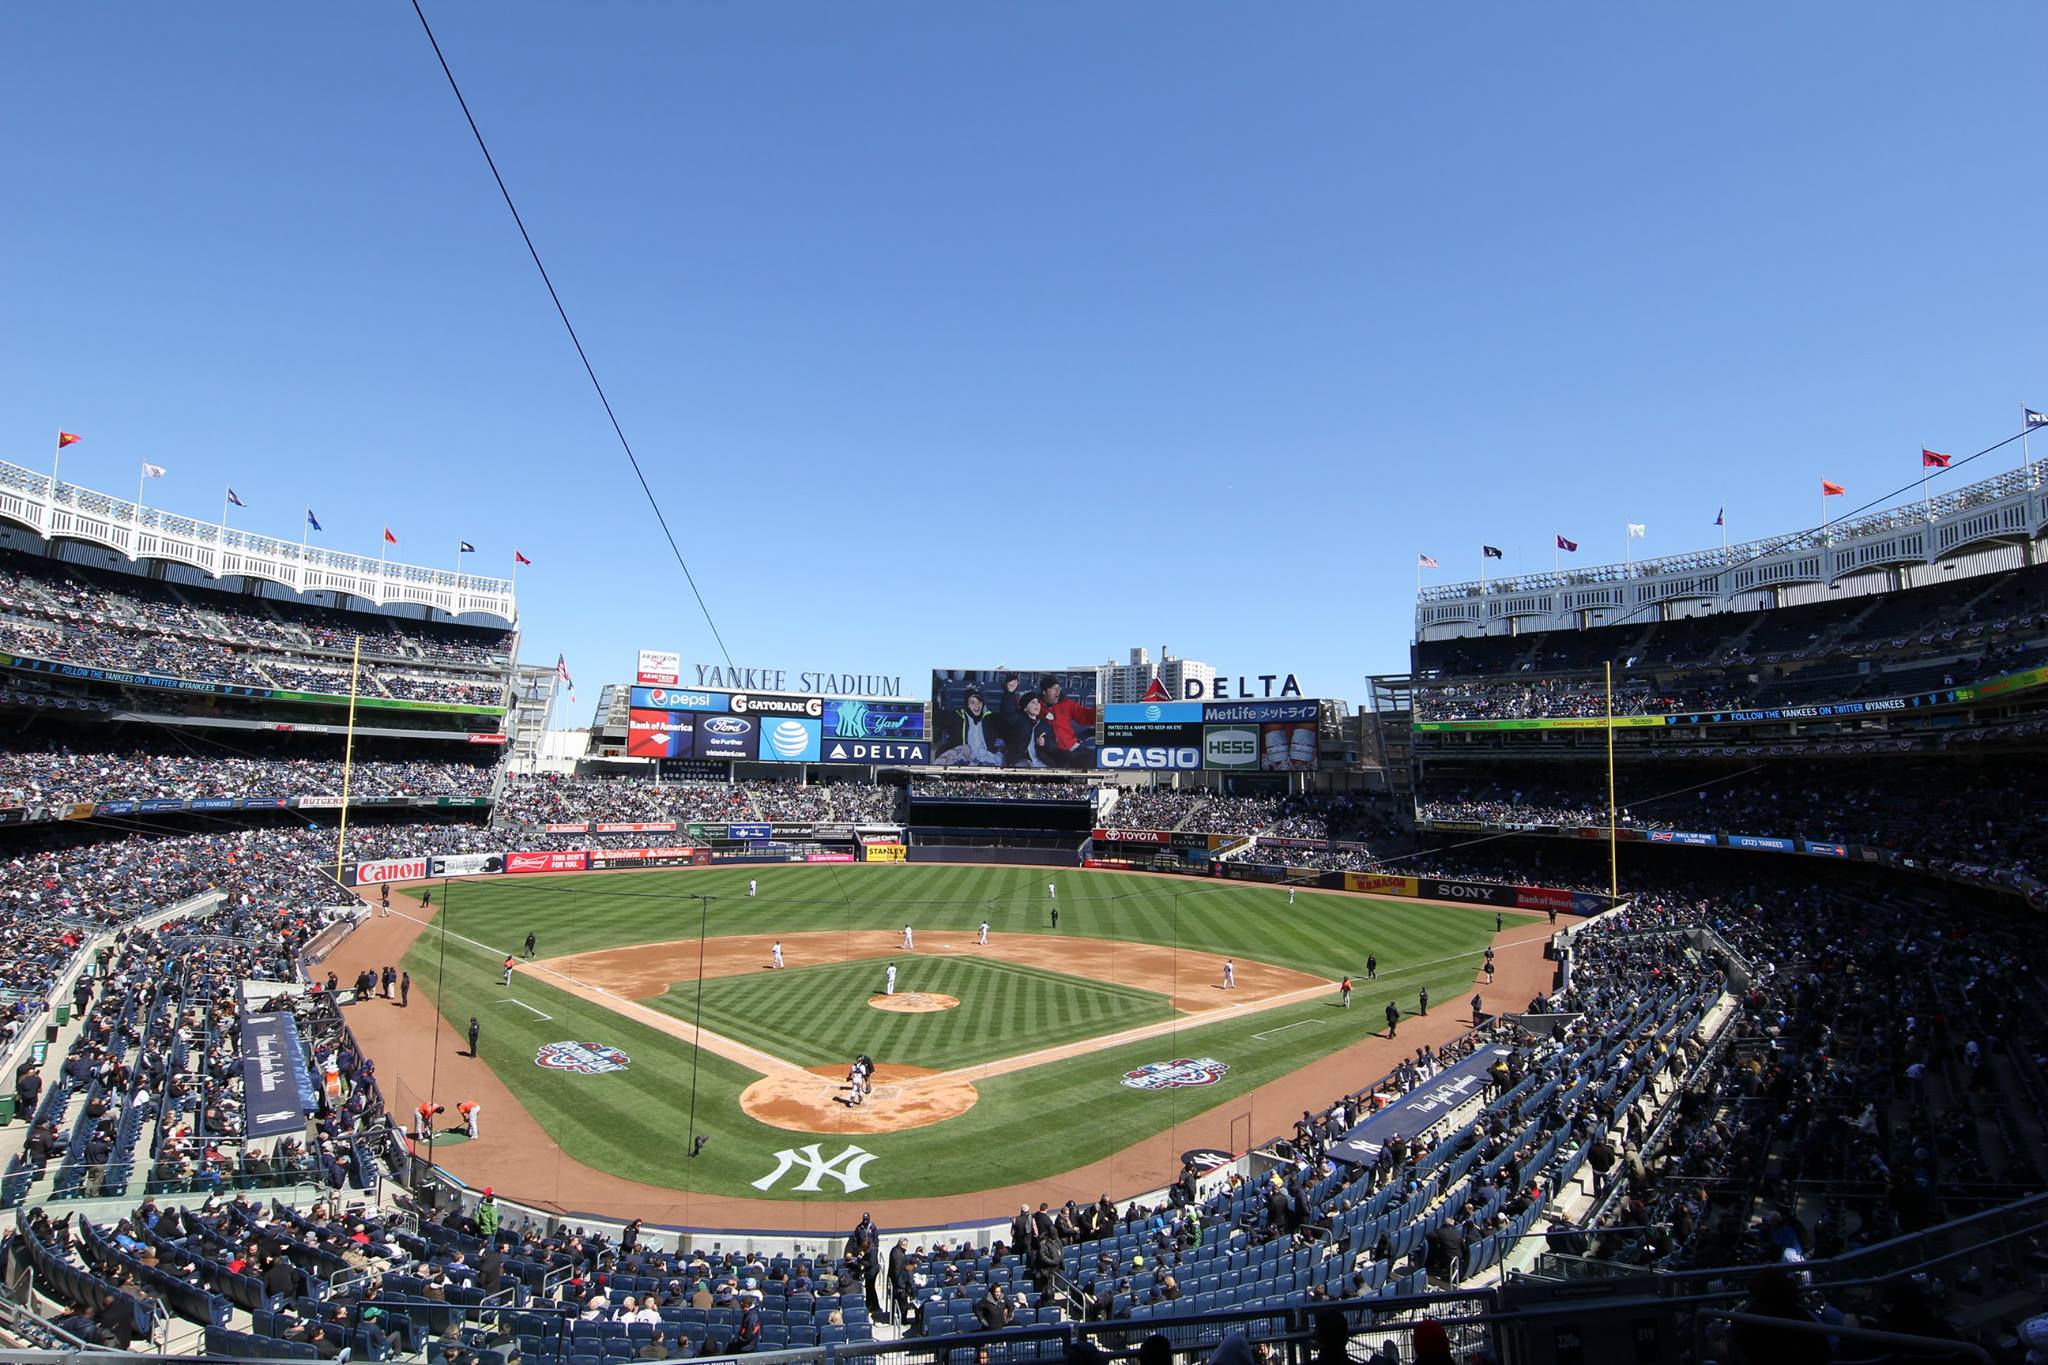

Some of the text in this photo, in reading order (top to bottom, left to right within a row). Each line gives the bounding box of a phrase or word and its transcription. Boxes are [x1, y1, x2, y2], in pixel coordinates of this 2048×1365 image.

[641, 653, 677, 662] ARMITRON
[61, 666, 215, 692] FOLLOW THE YANKEES ON TWITTER @YANKEES
[642, 673, 675, 683] ARMITRON
[693, 664, 902, 697] YANKEE STADIUM
[1184, 674, 1301, 700] DELTA
[670, 694, 709, 707] pepsi
[748, 699, 804, 712] GATORADE
[1205, 706, 1318, 720] MetLife メットライフ
[1731, 699, 1905, 721] FOLLOW THE YANKEES ON TWITTER @YANKEES
[630, 721, 693, 732] Bank of America
[712, 720, 742, 733] Ford
[854, 745, 923, 759] DELTA
[1209, 741, 1254, 754] HESS
[1101, 747, 1199, 768] CASIO
[303, 797, 344, 805] RUTGERS
[1121, 831, 1159, 841] TOYOTA
[1741, 838, 1783, 849] (212) YANKEES
[358, 863, 425, 883] Canon
[1438, 884, 1494, 899] SONY
[1518, 894, 1580, 909] Bank of America
